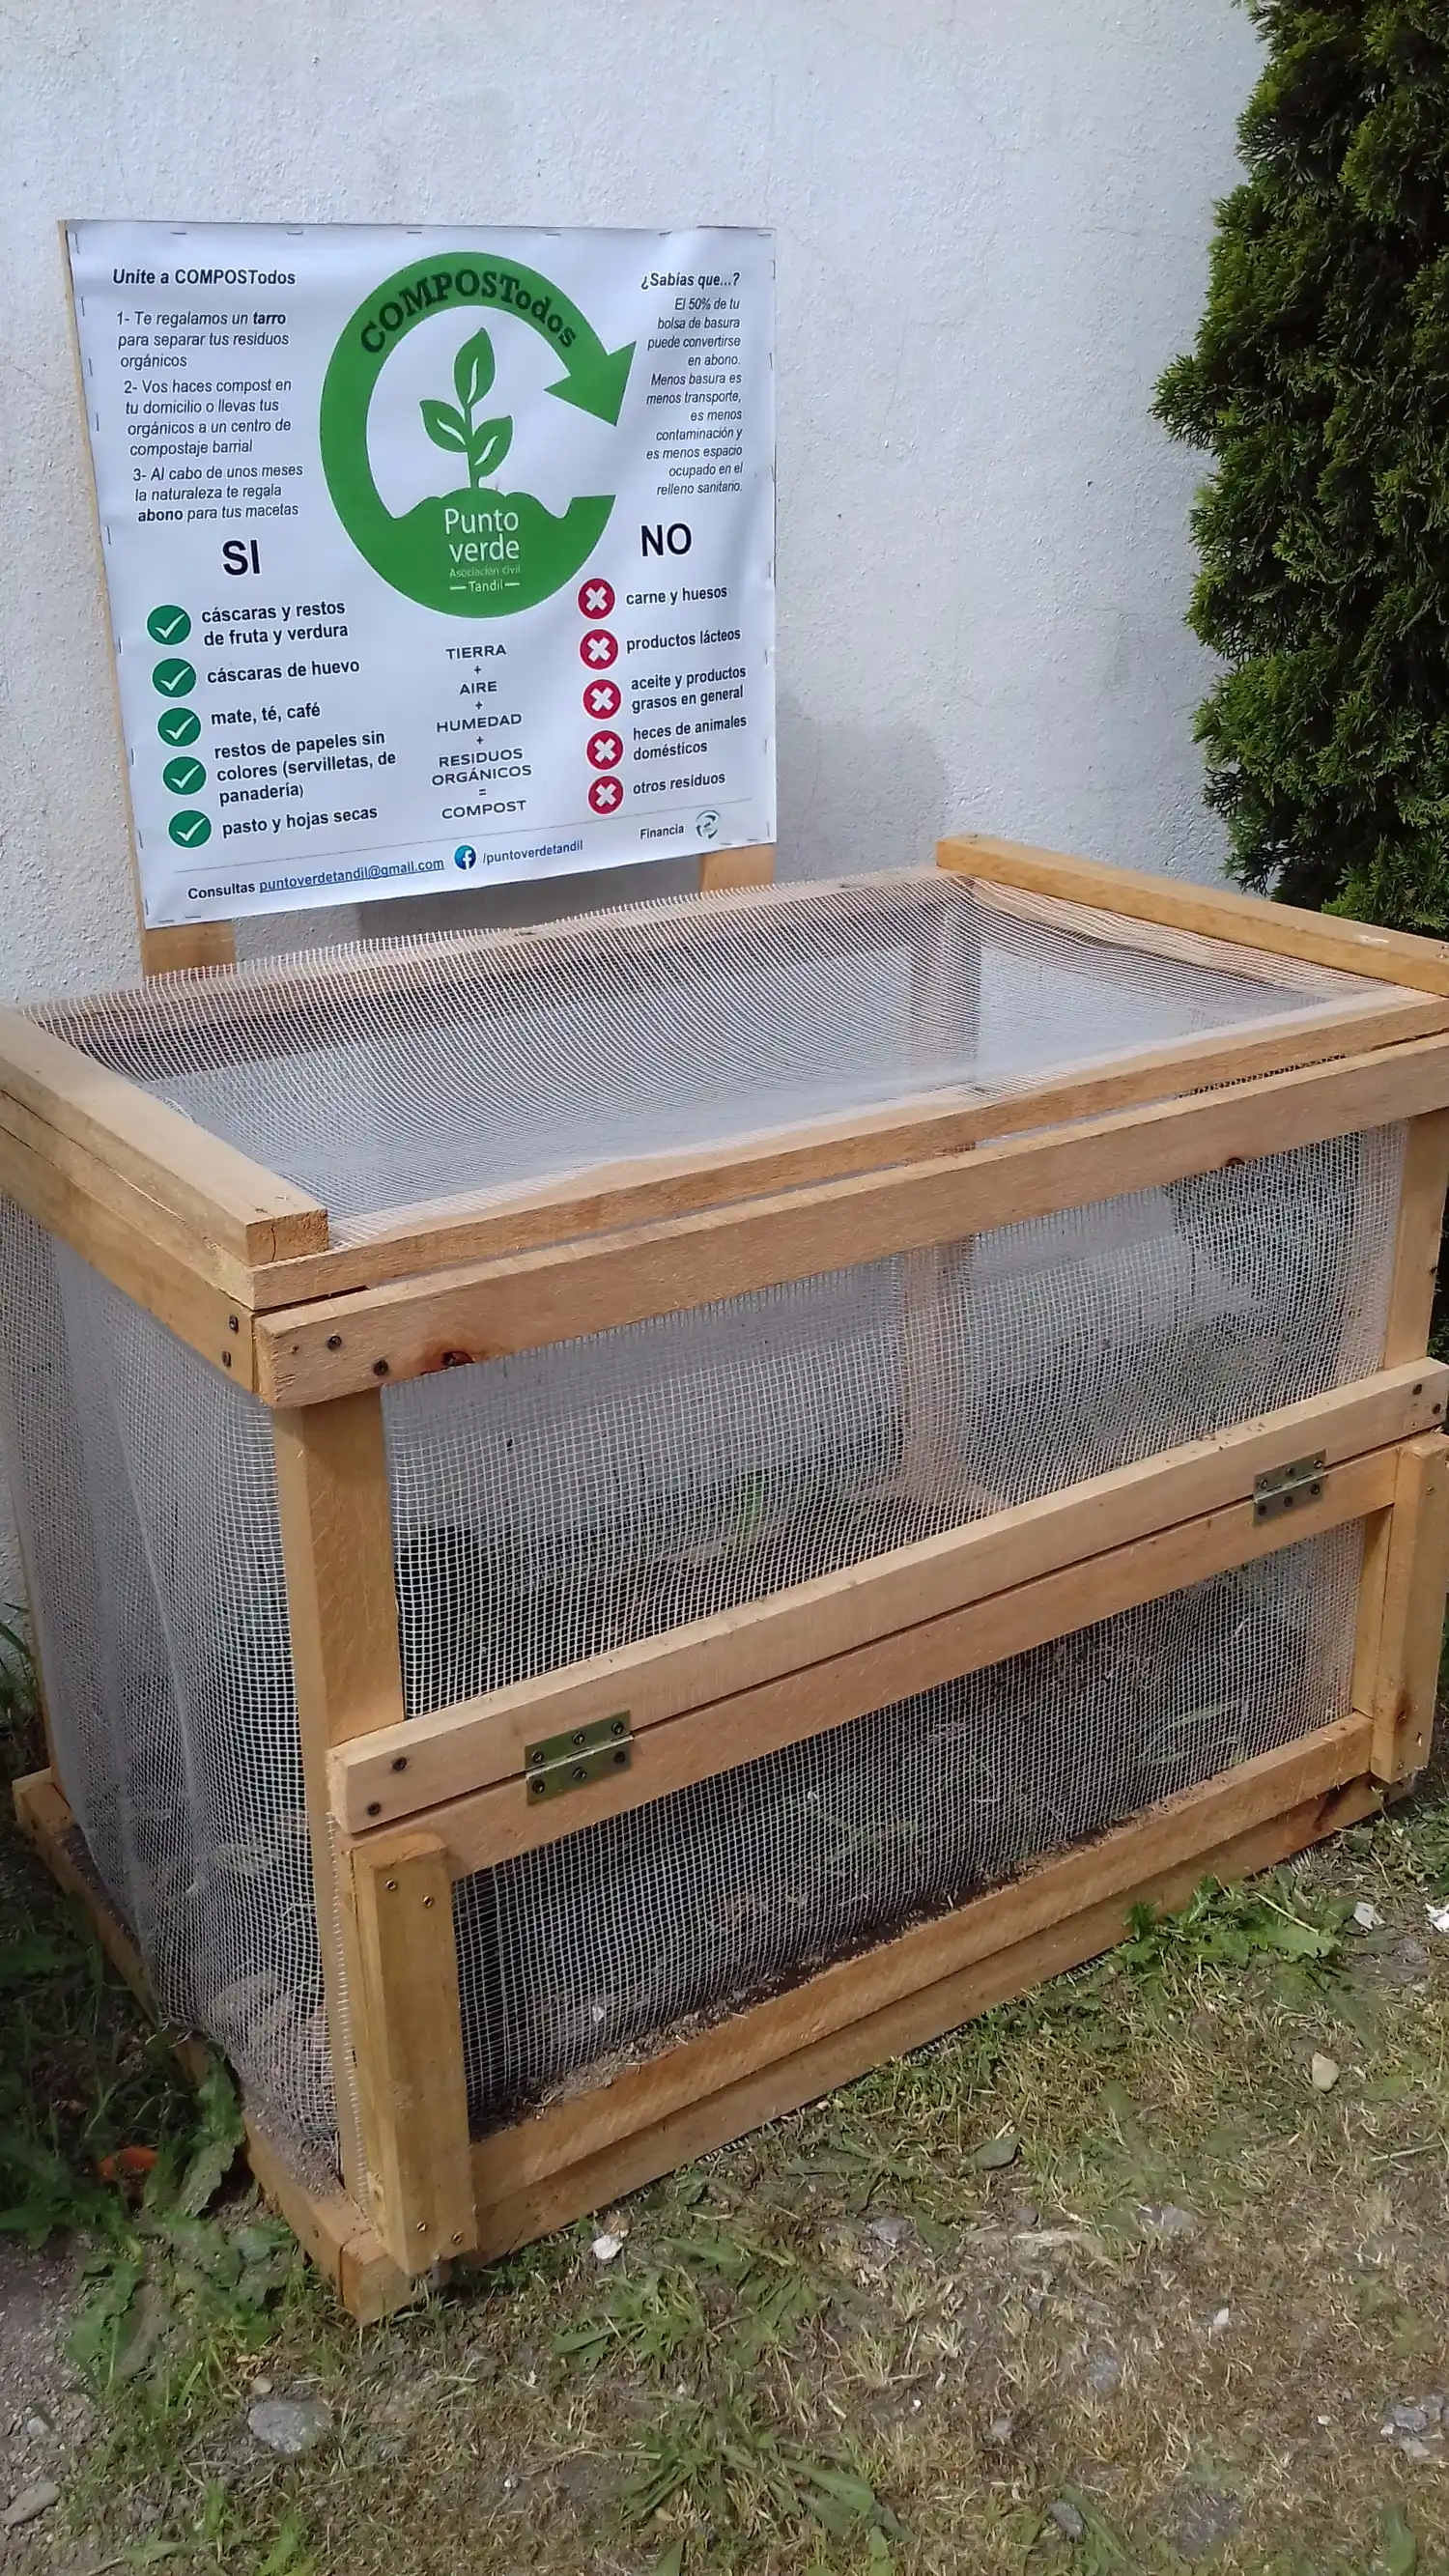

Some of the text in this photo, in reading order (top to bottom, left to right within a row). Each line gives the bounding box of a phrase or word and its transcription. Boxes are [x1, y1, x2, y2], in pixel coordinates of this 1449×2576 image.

[112, 268, 296, 285] Unite a COMPOSTodos
[640, 271, 740, 290] ¿Sabías que...?
[360, 269, 577, 354] COMPOSTodos
[674, 297, 740, 310] El 50% de tu
[117, 310, 287, 328] 1- Te regalamos un tarro
[657, 317, 740, 329] bolsa de basura
[118, 331, 289, 350] para separar tus residuos
[647, 334, 741, 352] puede convertirse
[120, 354, 187, 371] orgánicos
[688, 354, 740, 366] en abono.
[124, 379, 292, 394] 2- Vos haces compost en
[651, 373, 742, 386] Menos basura es
[126, 399, 279, 414] tu domicilio o llevas tus
[646, 390, 742, 406] menos transporte,
[690, 410, 743, 421] es menos
[128, 417, 292, 439] orgánicos a un centro de
[656, 426, 743, 441] contaminación y
[129, 439, 253, 458] compostaje barrial
[646, 444, 743, 460] es menos espacio
[132, 465, 303, 482] 3- Al cabo de unos meses
[668, 462, 744, 478] ocupado en el
[135, 483, 282, 502] la naturaleza te regala
[657, 483, 695, 495] relleno
[138, 503, 299, 524] abono para tus macetas
[444, 508, 519, 535] Punto
[448, 533, 520, 563] verde
[640, 523, 693, 557] NO
[222, 539, 261, 576] SI
[449, 564, 521, 578] Asociación civil
[468, 579, 503, 592] Tandil
[626, 586, 728, 606] carne y huesos
[201, 601, 346, 623] cáscaras y restos
[204, 623, 349, 646] de fruta y verdura
[626, 628, 741, 654] productos lácteos
[445, 644, 507, 661] TIERRA
[207, 660, 360, 684] cáscaras de huevo
[631, 666, 747, 691] aceite y productos
[459, 680, 497, 695] AIRE
[631, 685, 744, 714] grasos en general
[211, 701, 321, 725] mate, té, café
[437, 713, 523, 733] HUMEDAD
[633, 715, 748, 741] heces de animales
[214, 730, 385, 759] restos de papeles sin
[633, 740, 708, 761] domésticos
[216, 750, 396, 782] colores (servilletas, de
[439, 749, 524, 768] RESIDUOS
[432, 765, 532, 786] ORGÁNICOS
[633, 773, 725, 795] otros residuos
[219, 782, 304, 807] panadería)
[441, 800, 526, 819] COMPOST
[222, 807, 378, 839] pasto y hojas secas
[639, 823, 685, 840] Financia
[482, 839, 583, 865] /puntoverdetandil
[187, 859, 445, 900] Consultas puntoverdetandil@gmail.com
